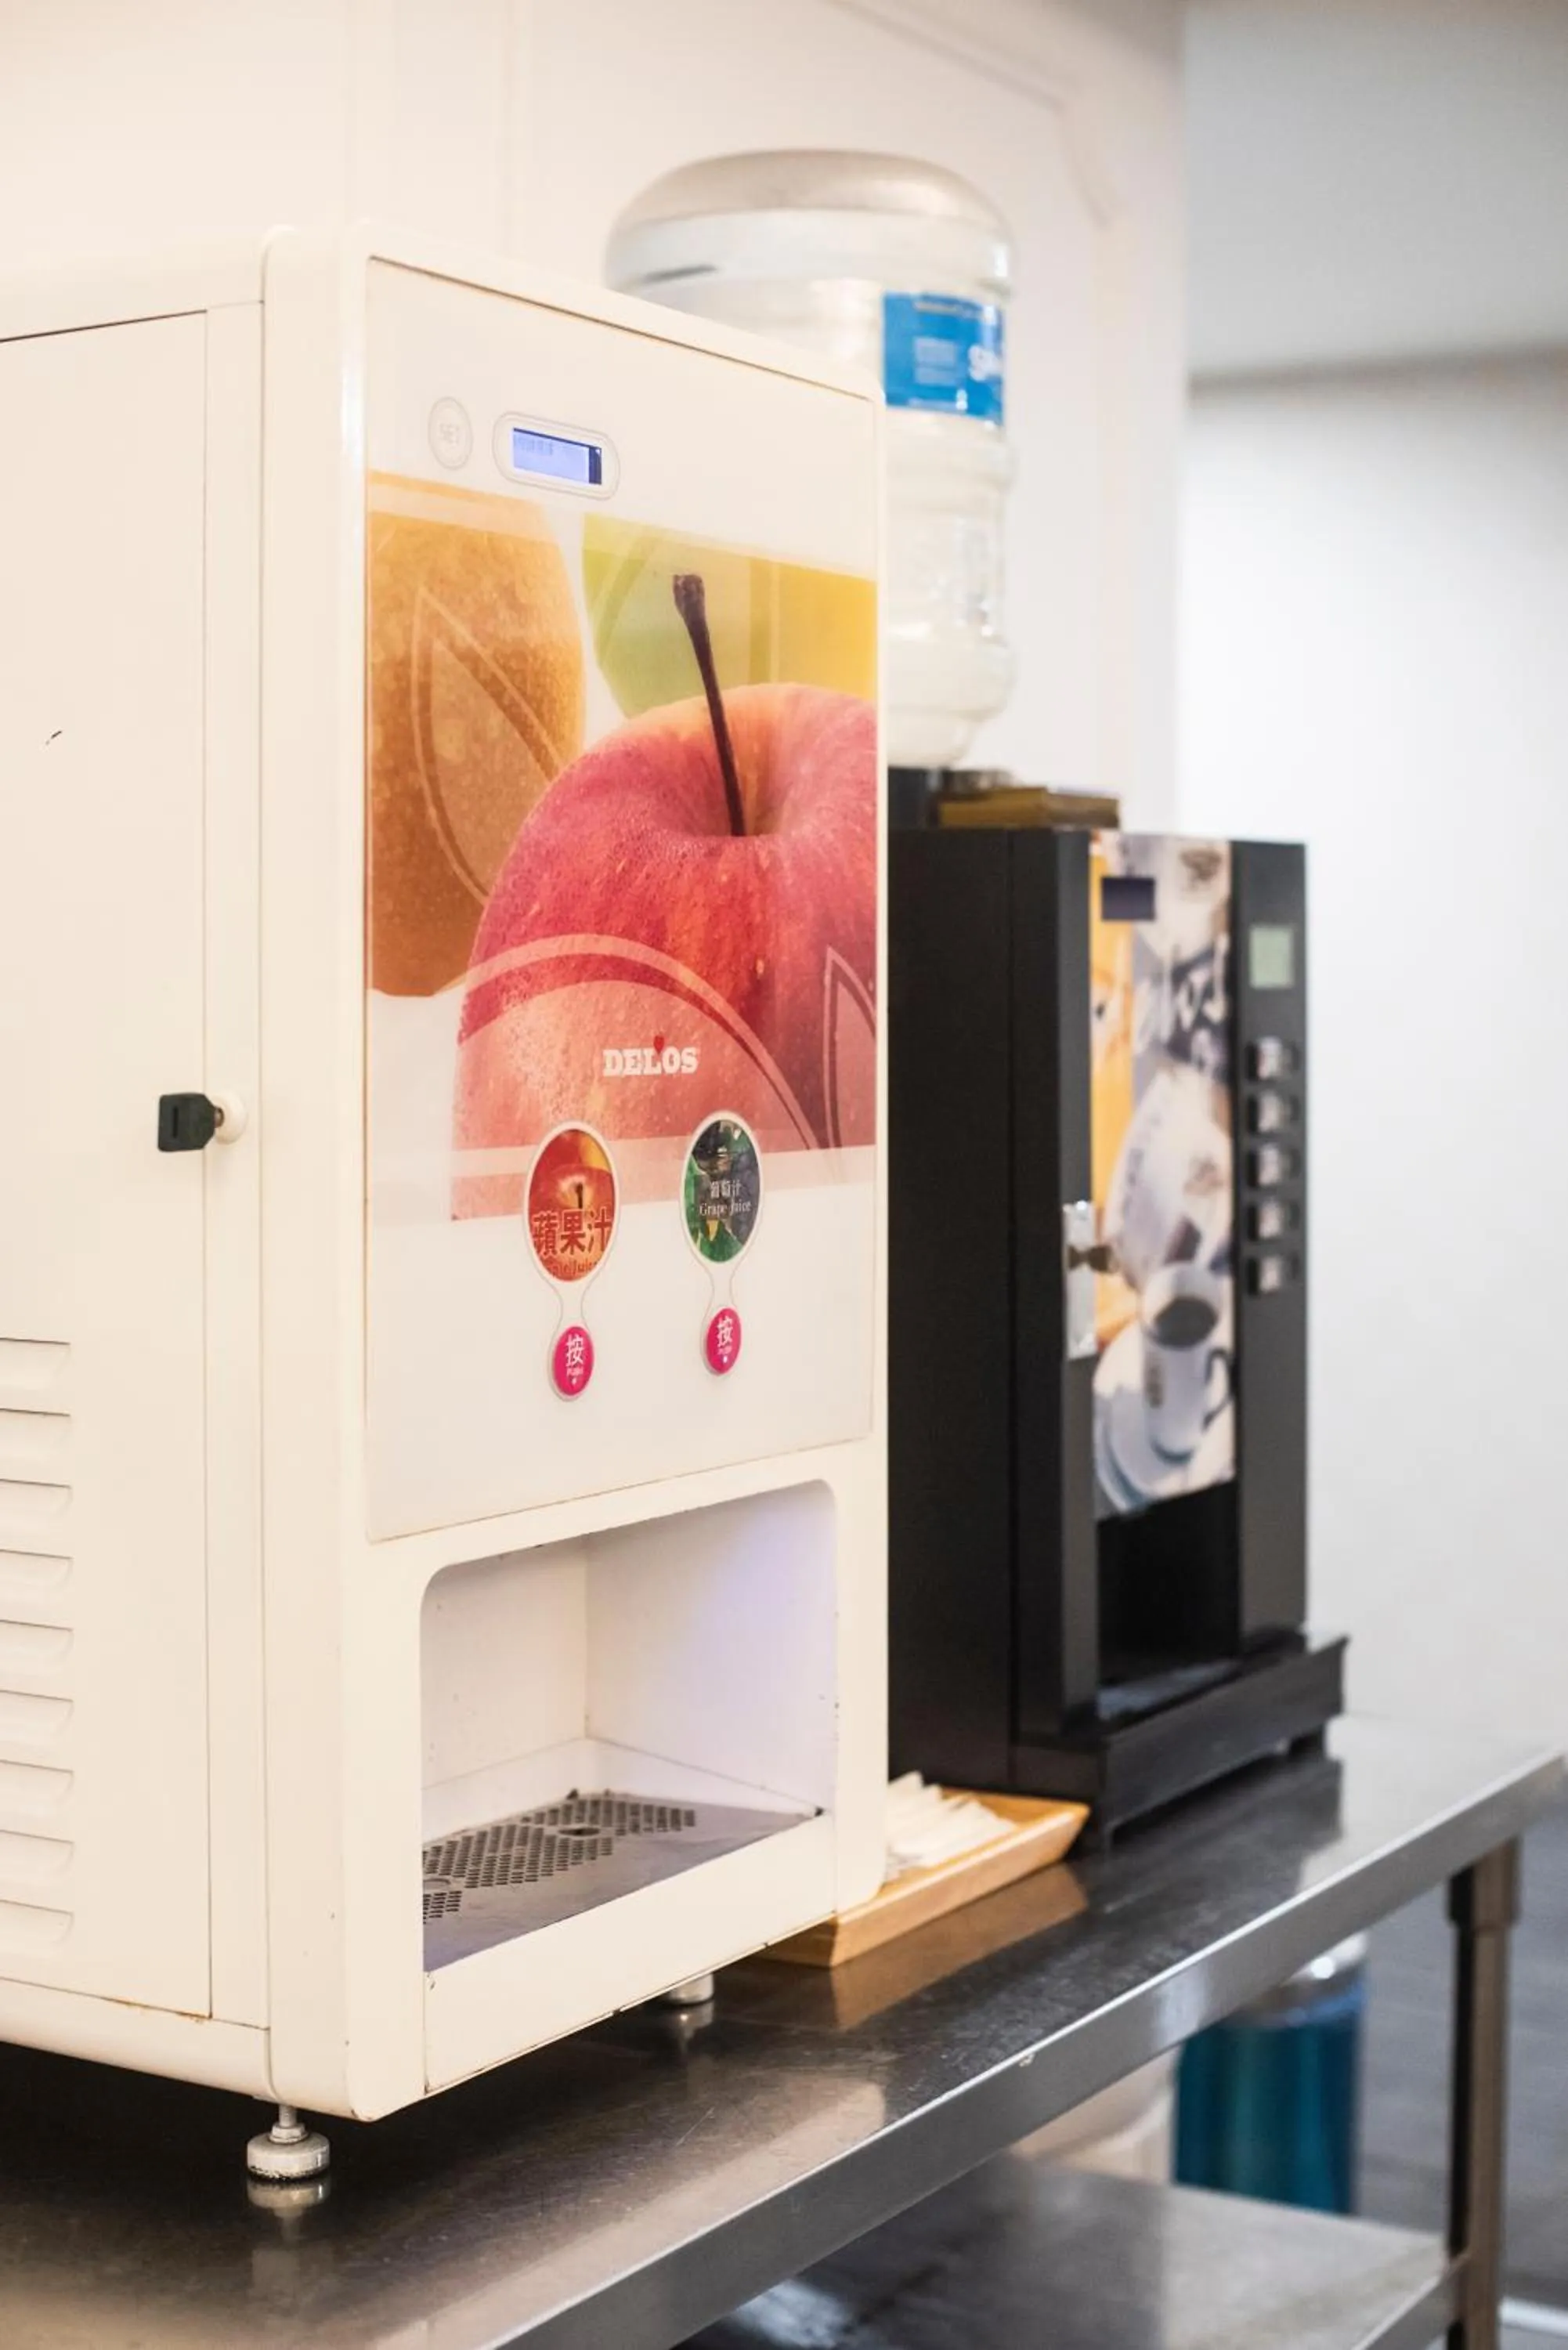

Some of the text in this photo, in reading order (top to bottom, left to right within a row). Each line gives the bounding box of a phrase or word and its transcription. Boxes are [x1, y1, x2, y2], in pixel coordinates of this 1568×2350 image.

[602, 1046, 699, 1077] DELOS
[699, 1202, 728, 1217] Grape
[533, 1209, 612, 1256] 蘋果汁
[565, 1334, 584, 1367] 按
